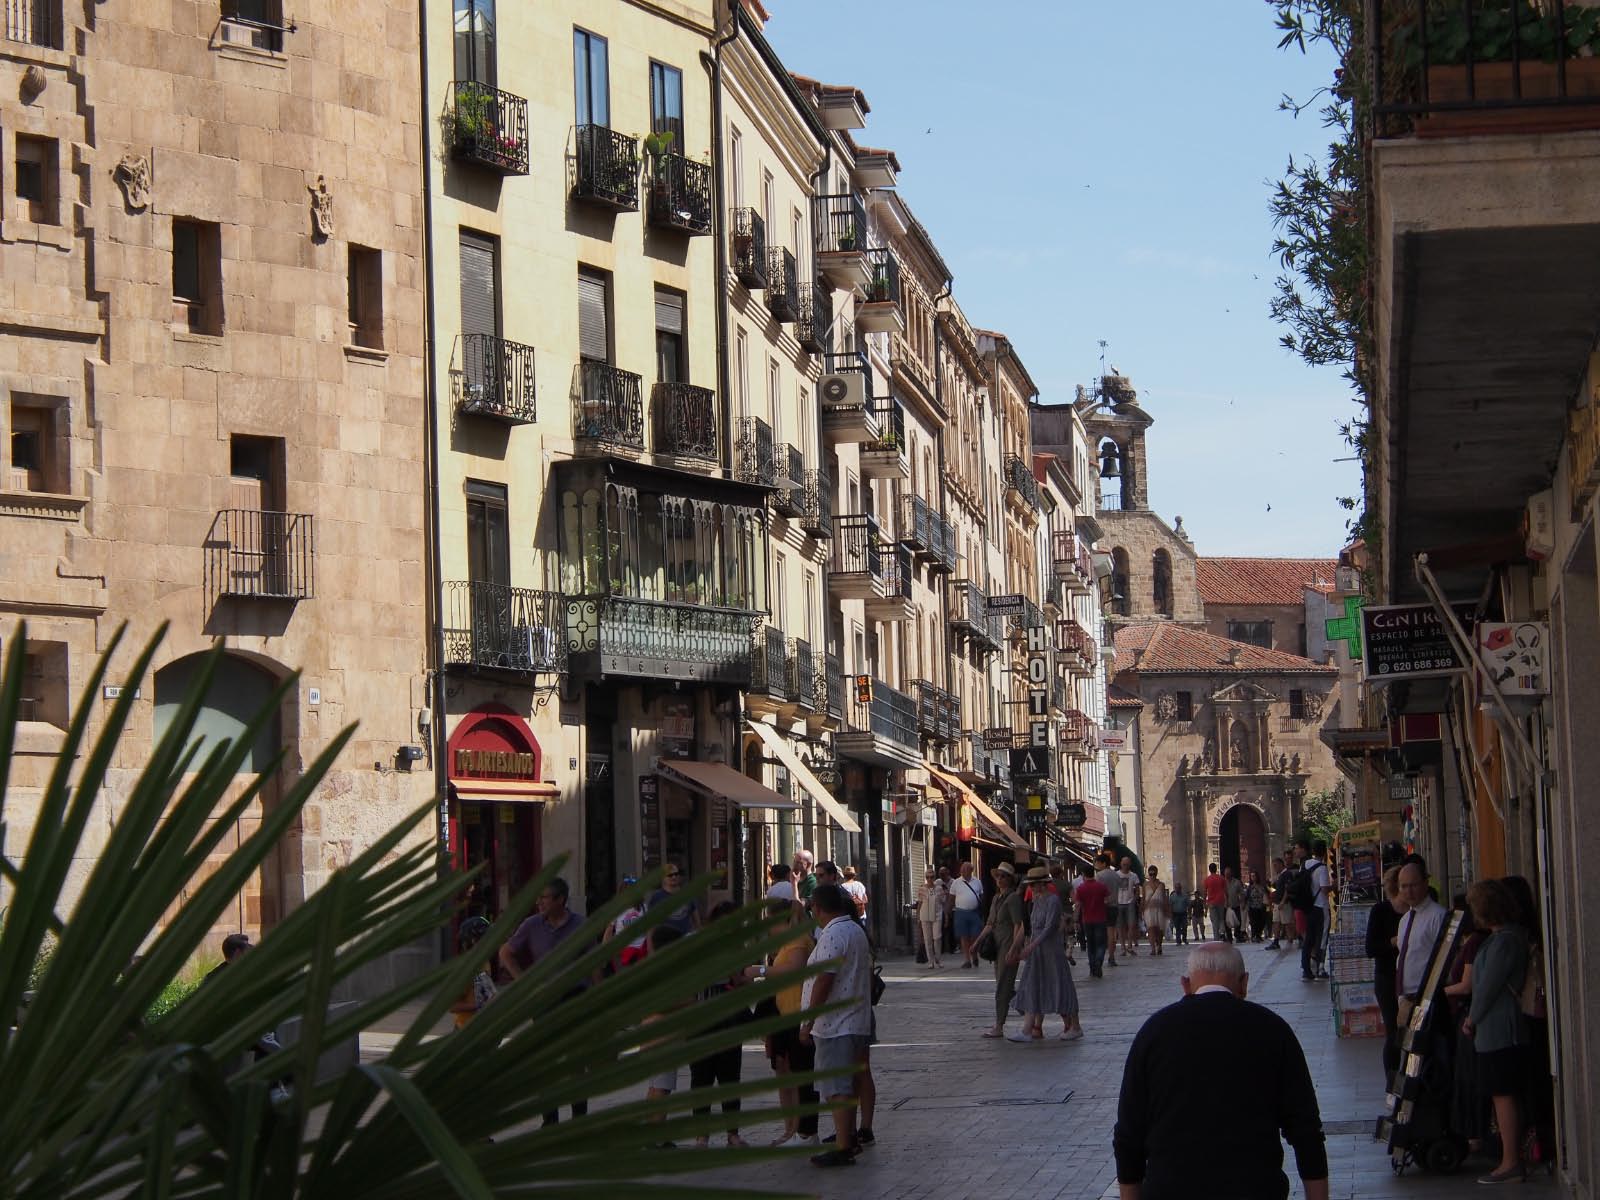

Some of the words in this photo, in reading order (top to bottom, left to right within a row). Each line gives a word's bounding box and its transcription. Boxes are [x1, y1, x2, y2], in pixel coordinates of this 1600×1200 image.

[991, 596, 1020, 606] RESIDENCIA
[987, 605, 1025, 616] UNIVERSITARIA
[1370, 630, 1409, 641] ESPACIO
[1393, 662, 1411, 671] 620
[1414, 660, 1432, 670] 686
[1435, 658, 1452, 668] 369
[857, 676, 867, 686] SE
[1028, 627, 1046, 746] HOTE
